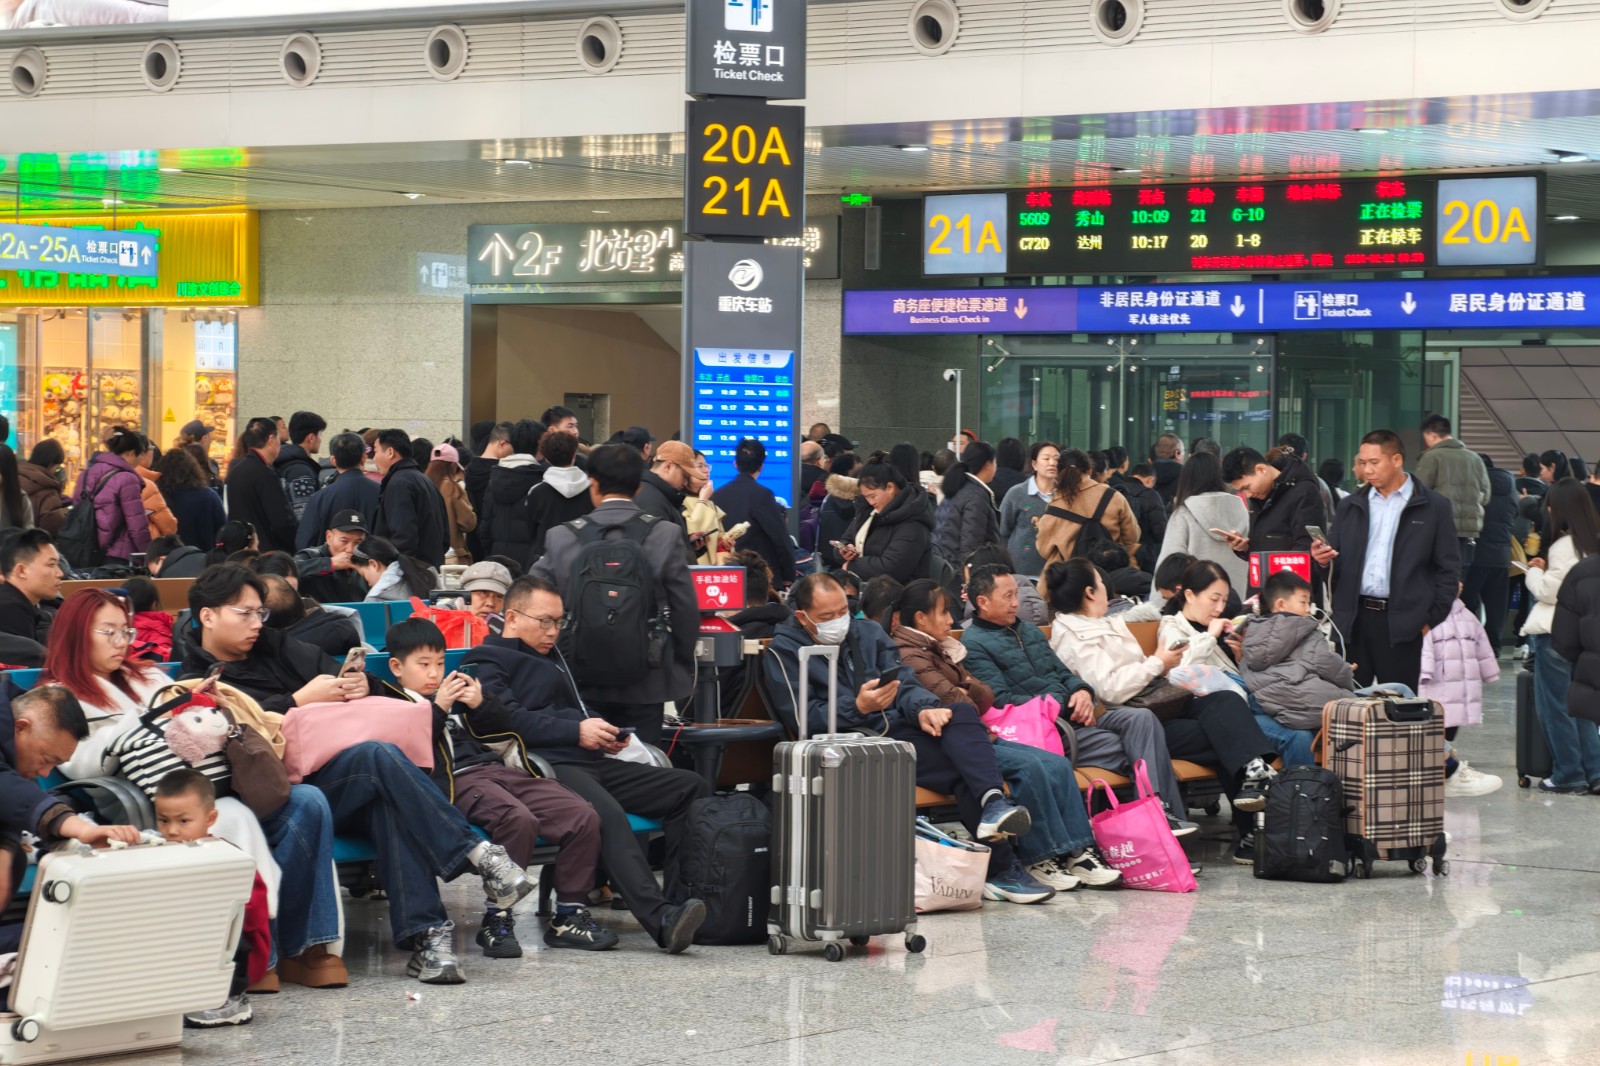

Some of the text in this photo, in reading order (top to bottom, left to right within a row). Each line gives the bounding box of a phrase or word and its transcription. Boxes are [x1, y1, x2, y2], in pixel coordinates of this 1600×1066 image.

[713, 40, 785, 67] 检票口
[713, 68, 784, 82] Ticket Check
[702, 123, 791, 166] 20A
[702, 175, 791, 217] 21A
[1019, 201, 1423, 227] 5609 秀山 10:09 21 6-10 正在检票
[1443, 199, 1531, 245] 20A
[928, 213, 1003, 255] 21A
[1077, 235, 1103, 250] 达州
[1131, 235, 1168, 249] 10:17
[1190, 234, 1209, 248] 20
[1236, 233, 1262, 248] 1-8
[1359, 227, 1423, 245] 正在候车
[0, 232, 82, 264] 2A-25A
[86, 240, 118, 254] 检票口
[513, 231, 563, 276] 2F
[718, 296, 773, 313] 重庆车站
[893, 297, 1008, 313] 商务座便捷检票通道
[1100, 290, 1222, 308] 非居民身份证通道
[1322, 293, 1358, 307] 检票口
[1449, 292, 1586, 312] 居民身份证通道
[910, 316, 939, 324] Business
[959, 315, 981, 323] Check
[1128, 313, 1191, 325] 军人依法优先
[1322, 308, 1372, 317] Ticket Check
[718, 352, 771, 365] 出发信息
[695, 574, 738, 584] 手机加油站
